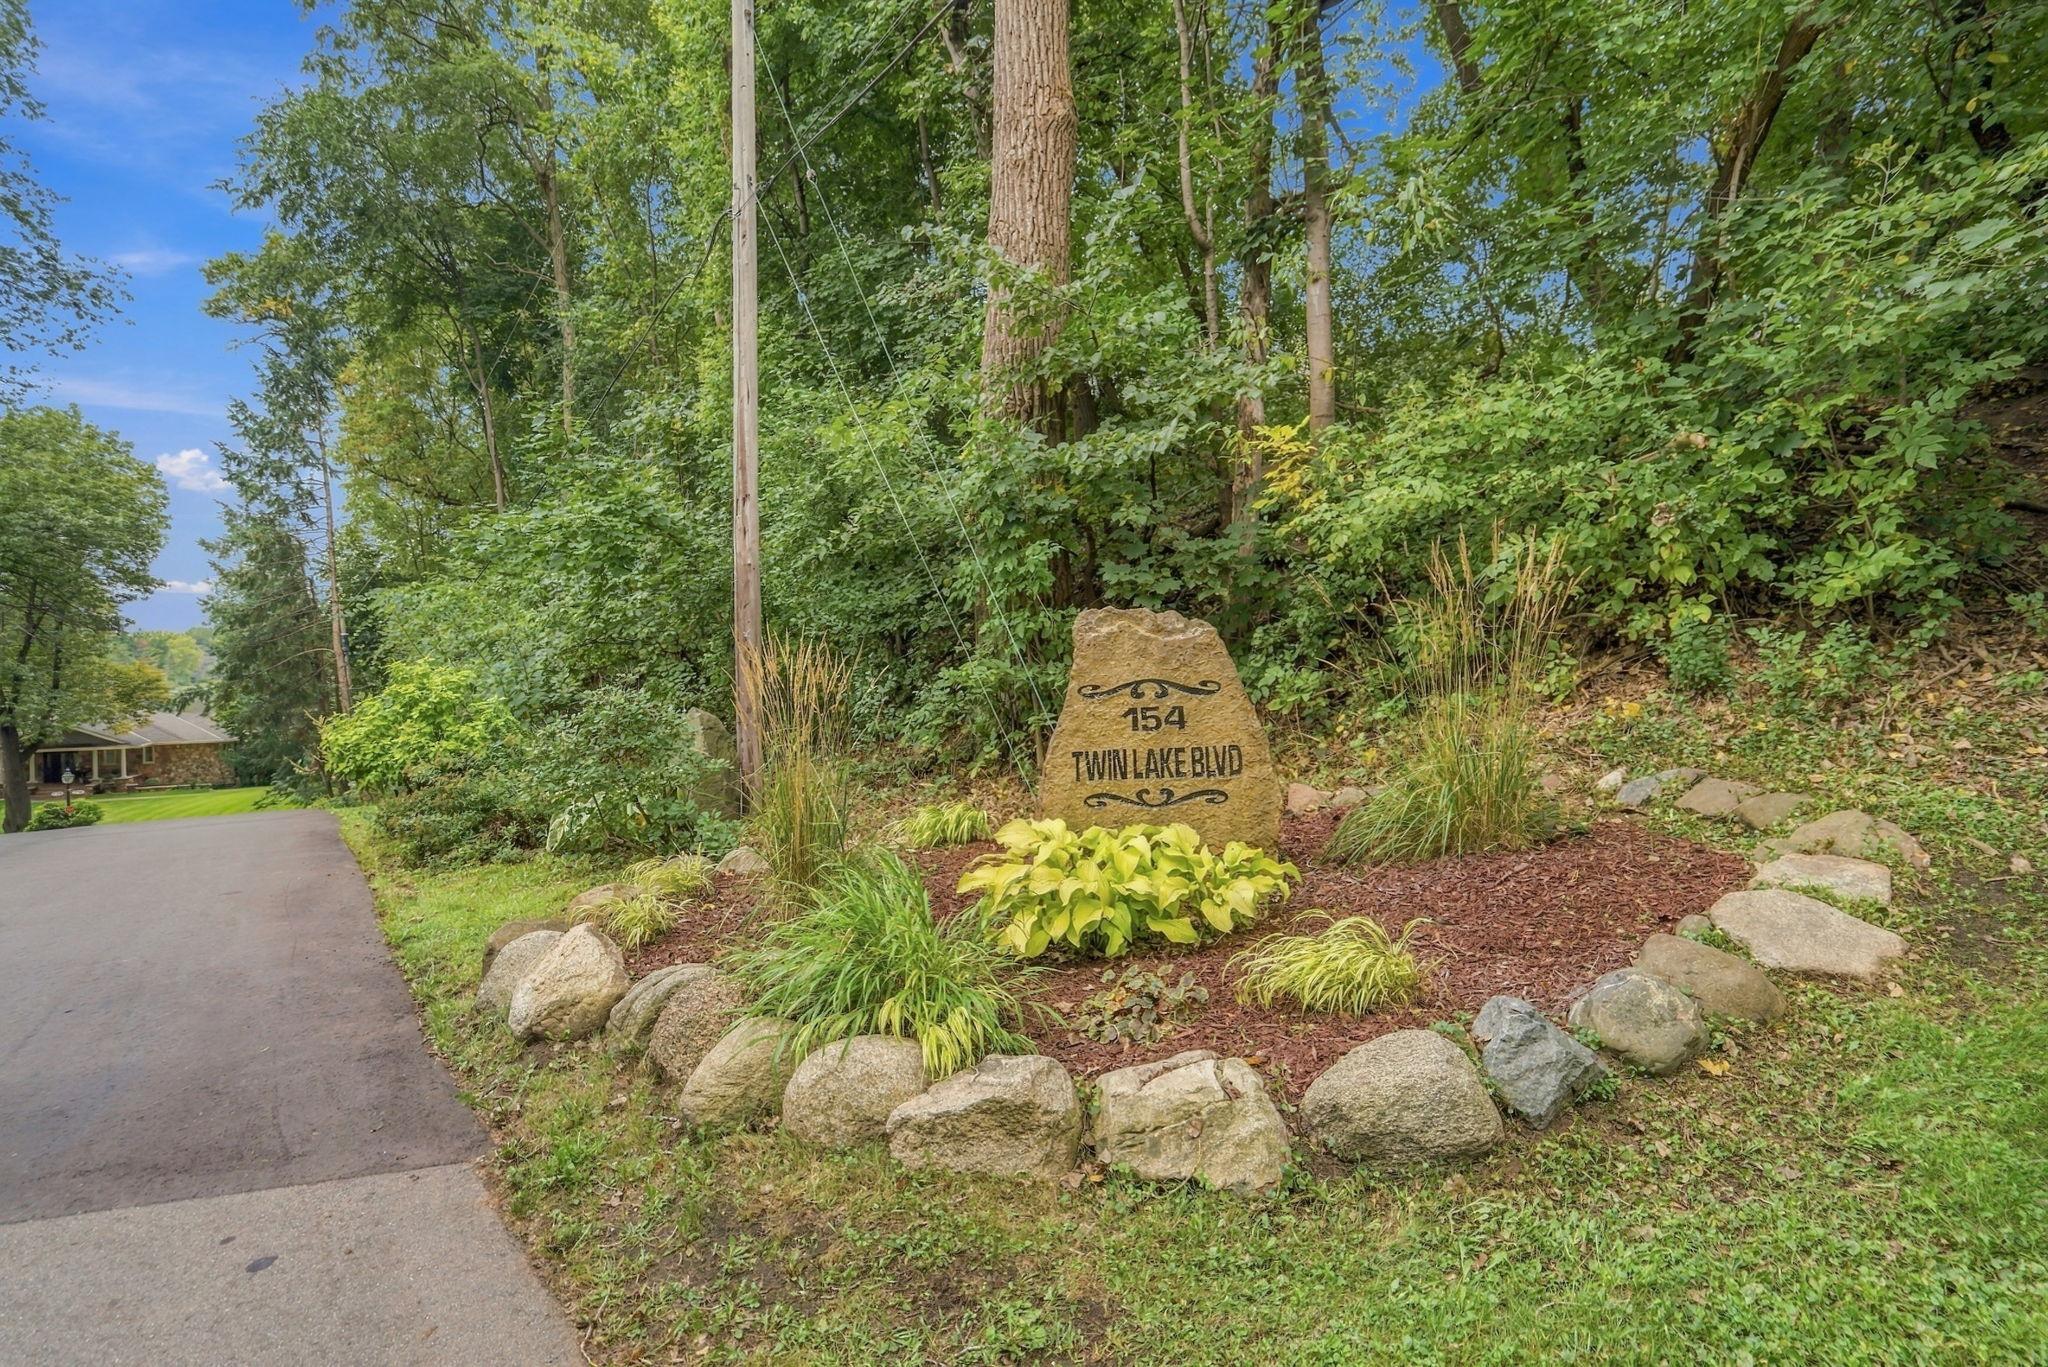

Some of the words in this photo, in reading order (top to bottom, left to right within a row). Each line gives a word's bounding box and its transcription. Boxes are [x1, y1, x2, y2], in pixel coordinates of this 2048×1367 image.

[1121, 705, 1188, 732] 154
[1071, 748, 1128, 782] TWIN
[1133, 747, 1186, 780] LAKE
[1190, 744, 1243, 779] BLVD
